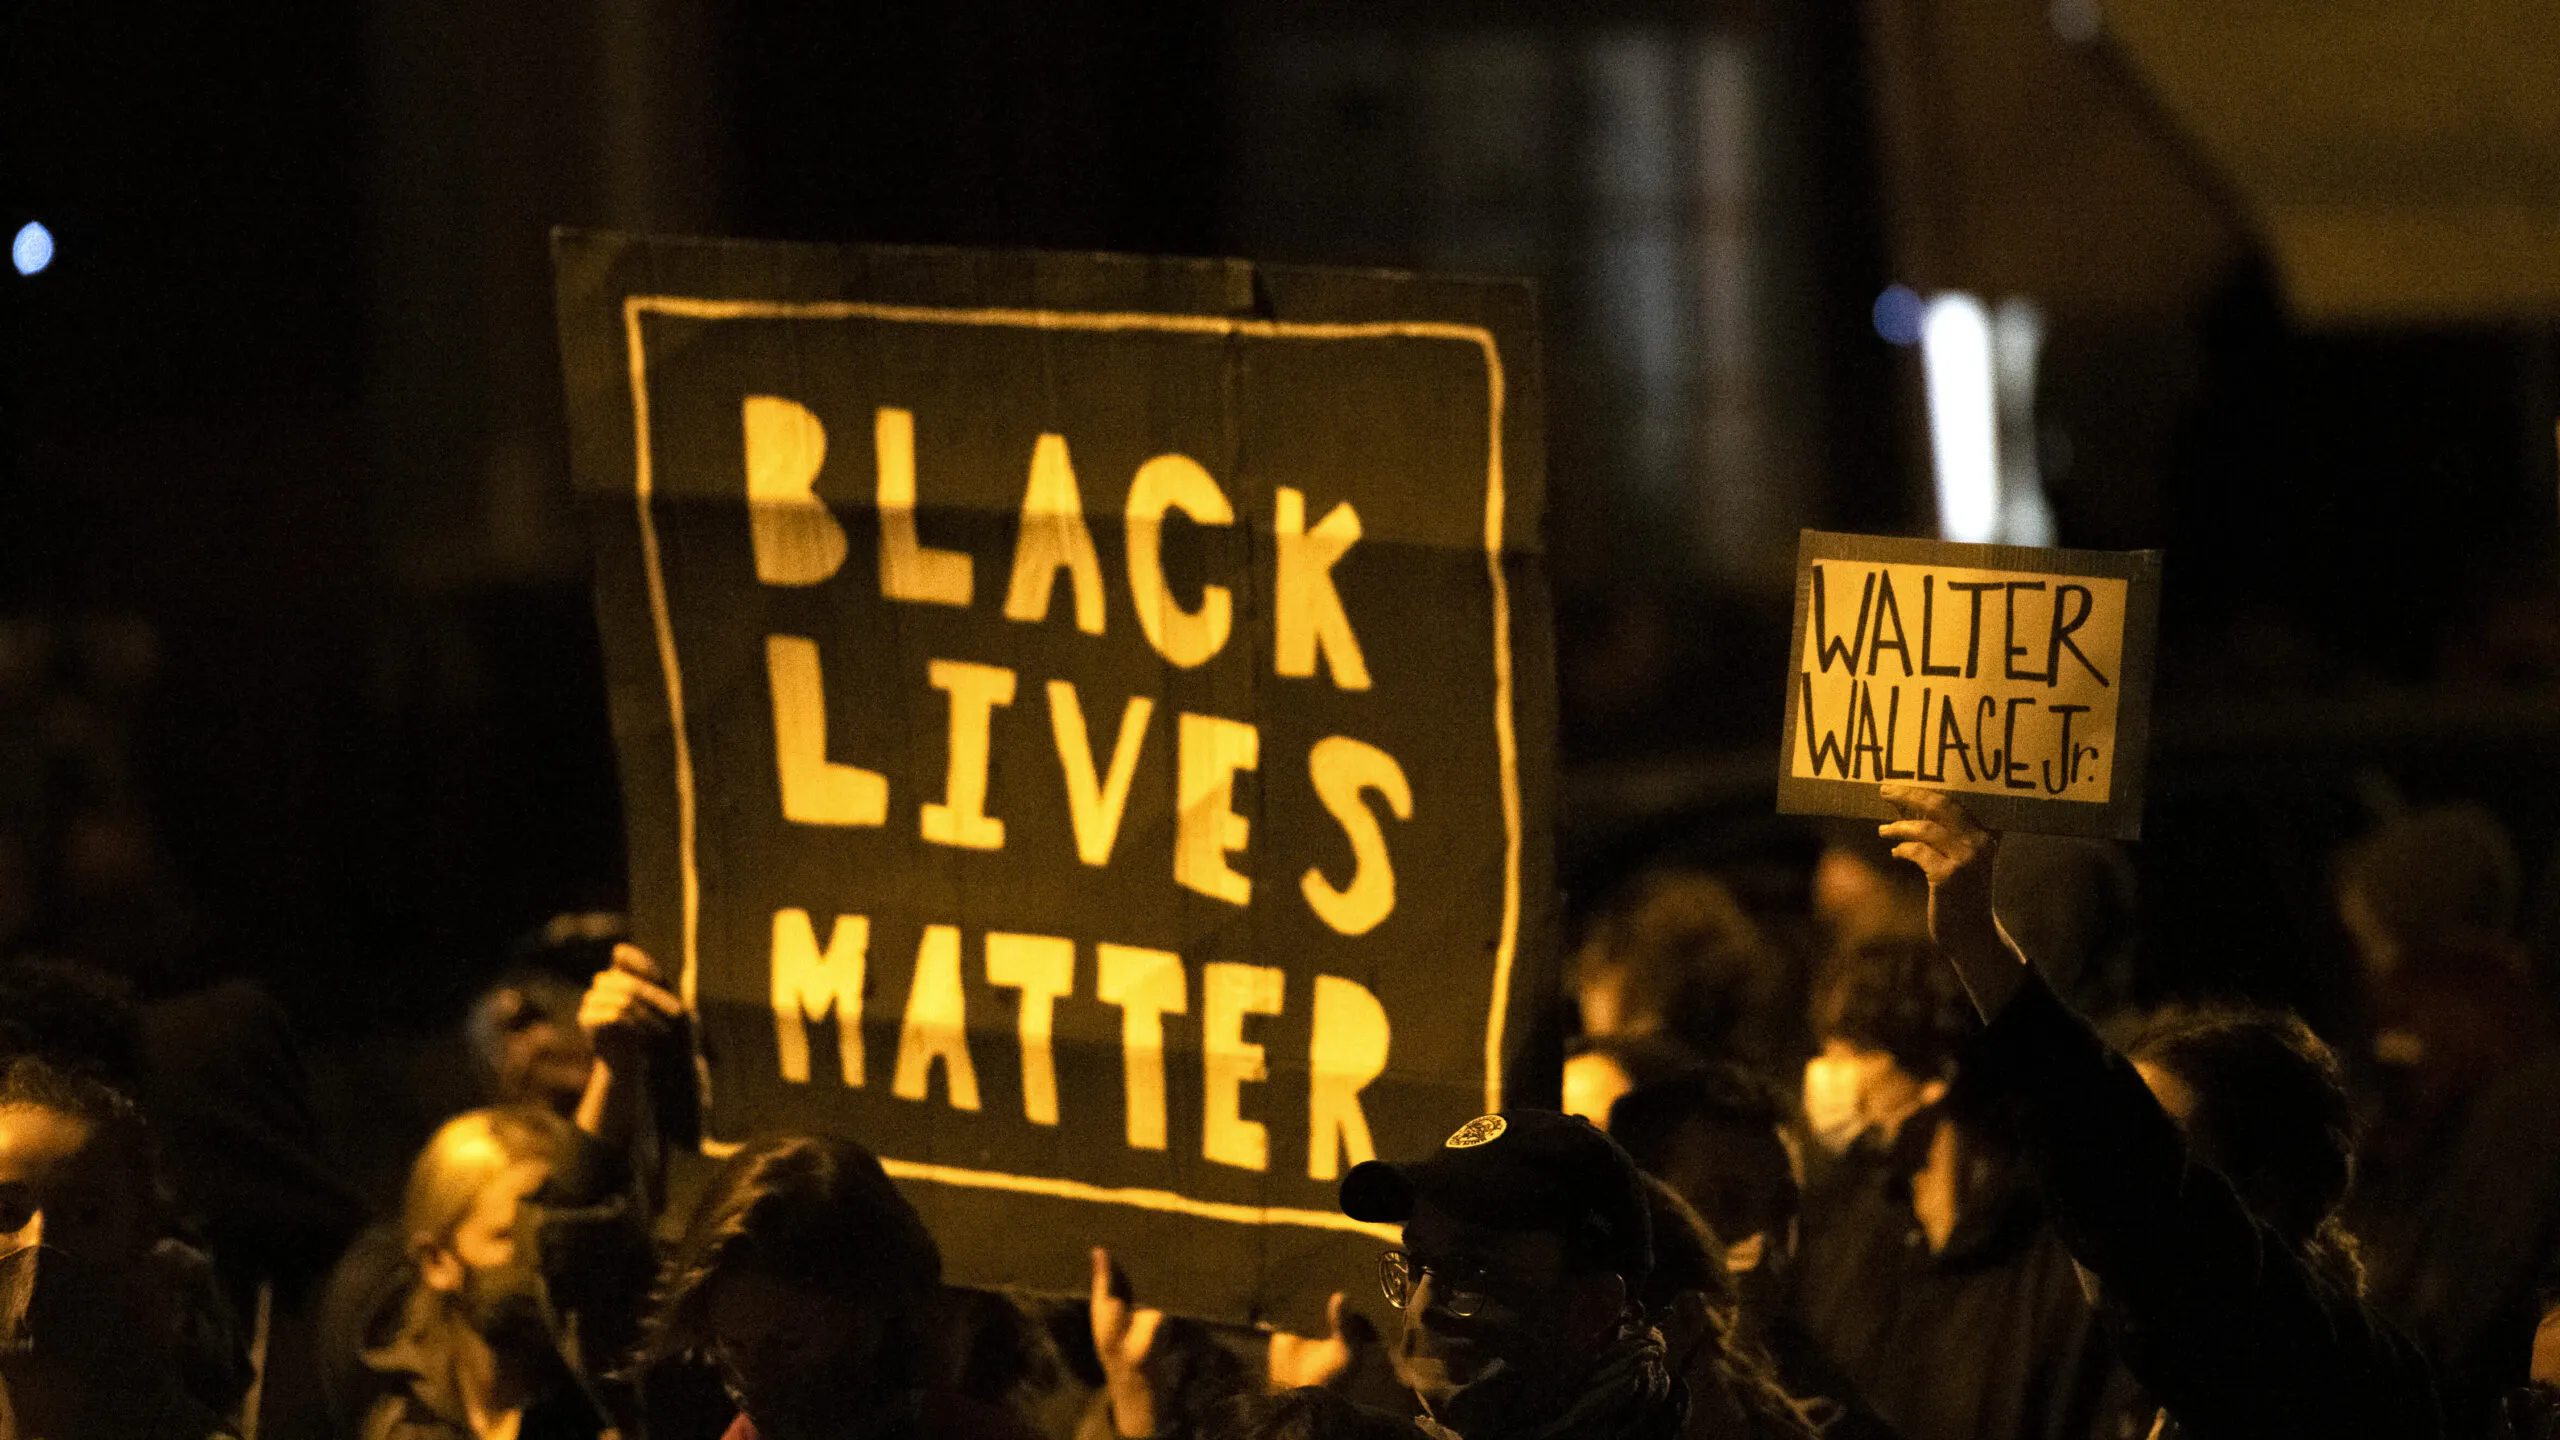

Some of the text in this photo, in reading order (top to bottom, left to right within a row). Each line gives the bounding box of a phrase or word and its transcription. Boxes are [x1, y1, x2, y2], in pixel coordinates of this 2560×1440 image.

[742, 395, 1373, 690] BLACK
[1812, 563, 2110, 688] WALTER
[765, 634, 1413, 936] LIVES
[1801, 671, 2099, 795] WALLACE Jr.
[771, 907, 1391, 1181] MATTER
